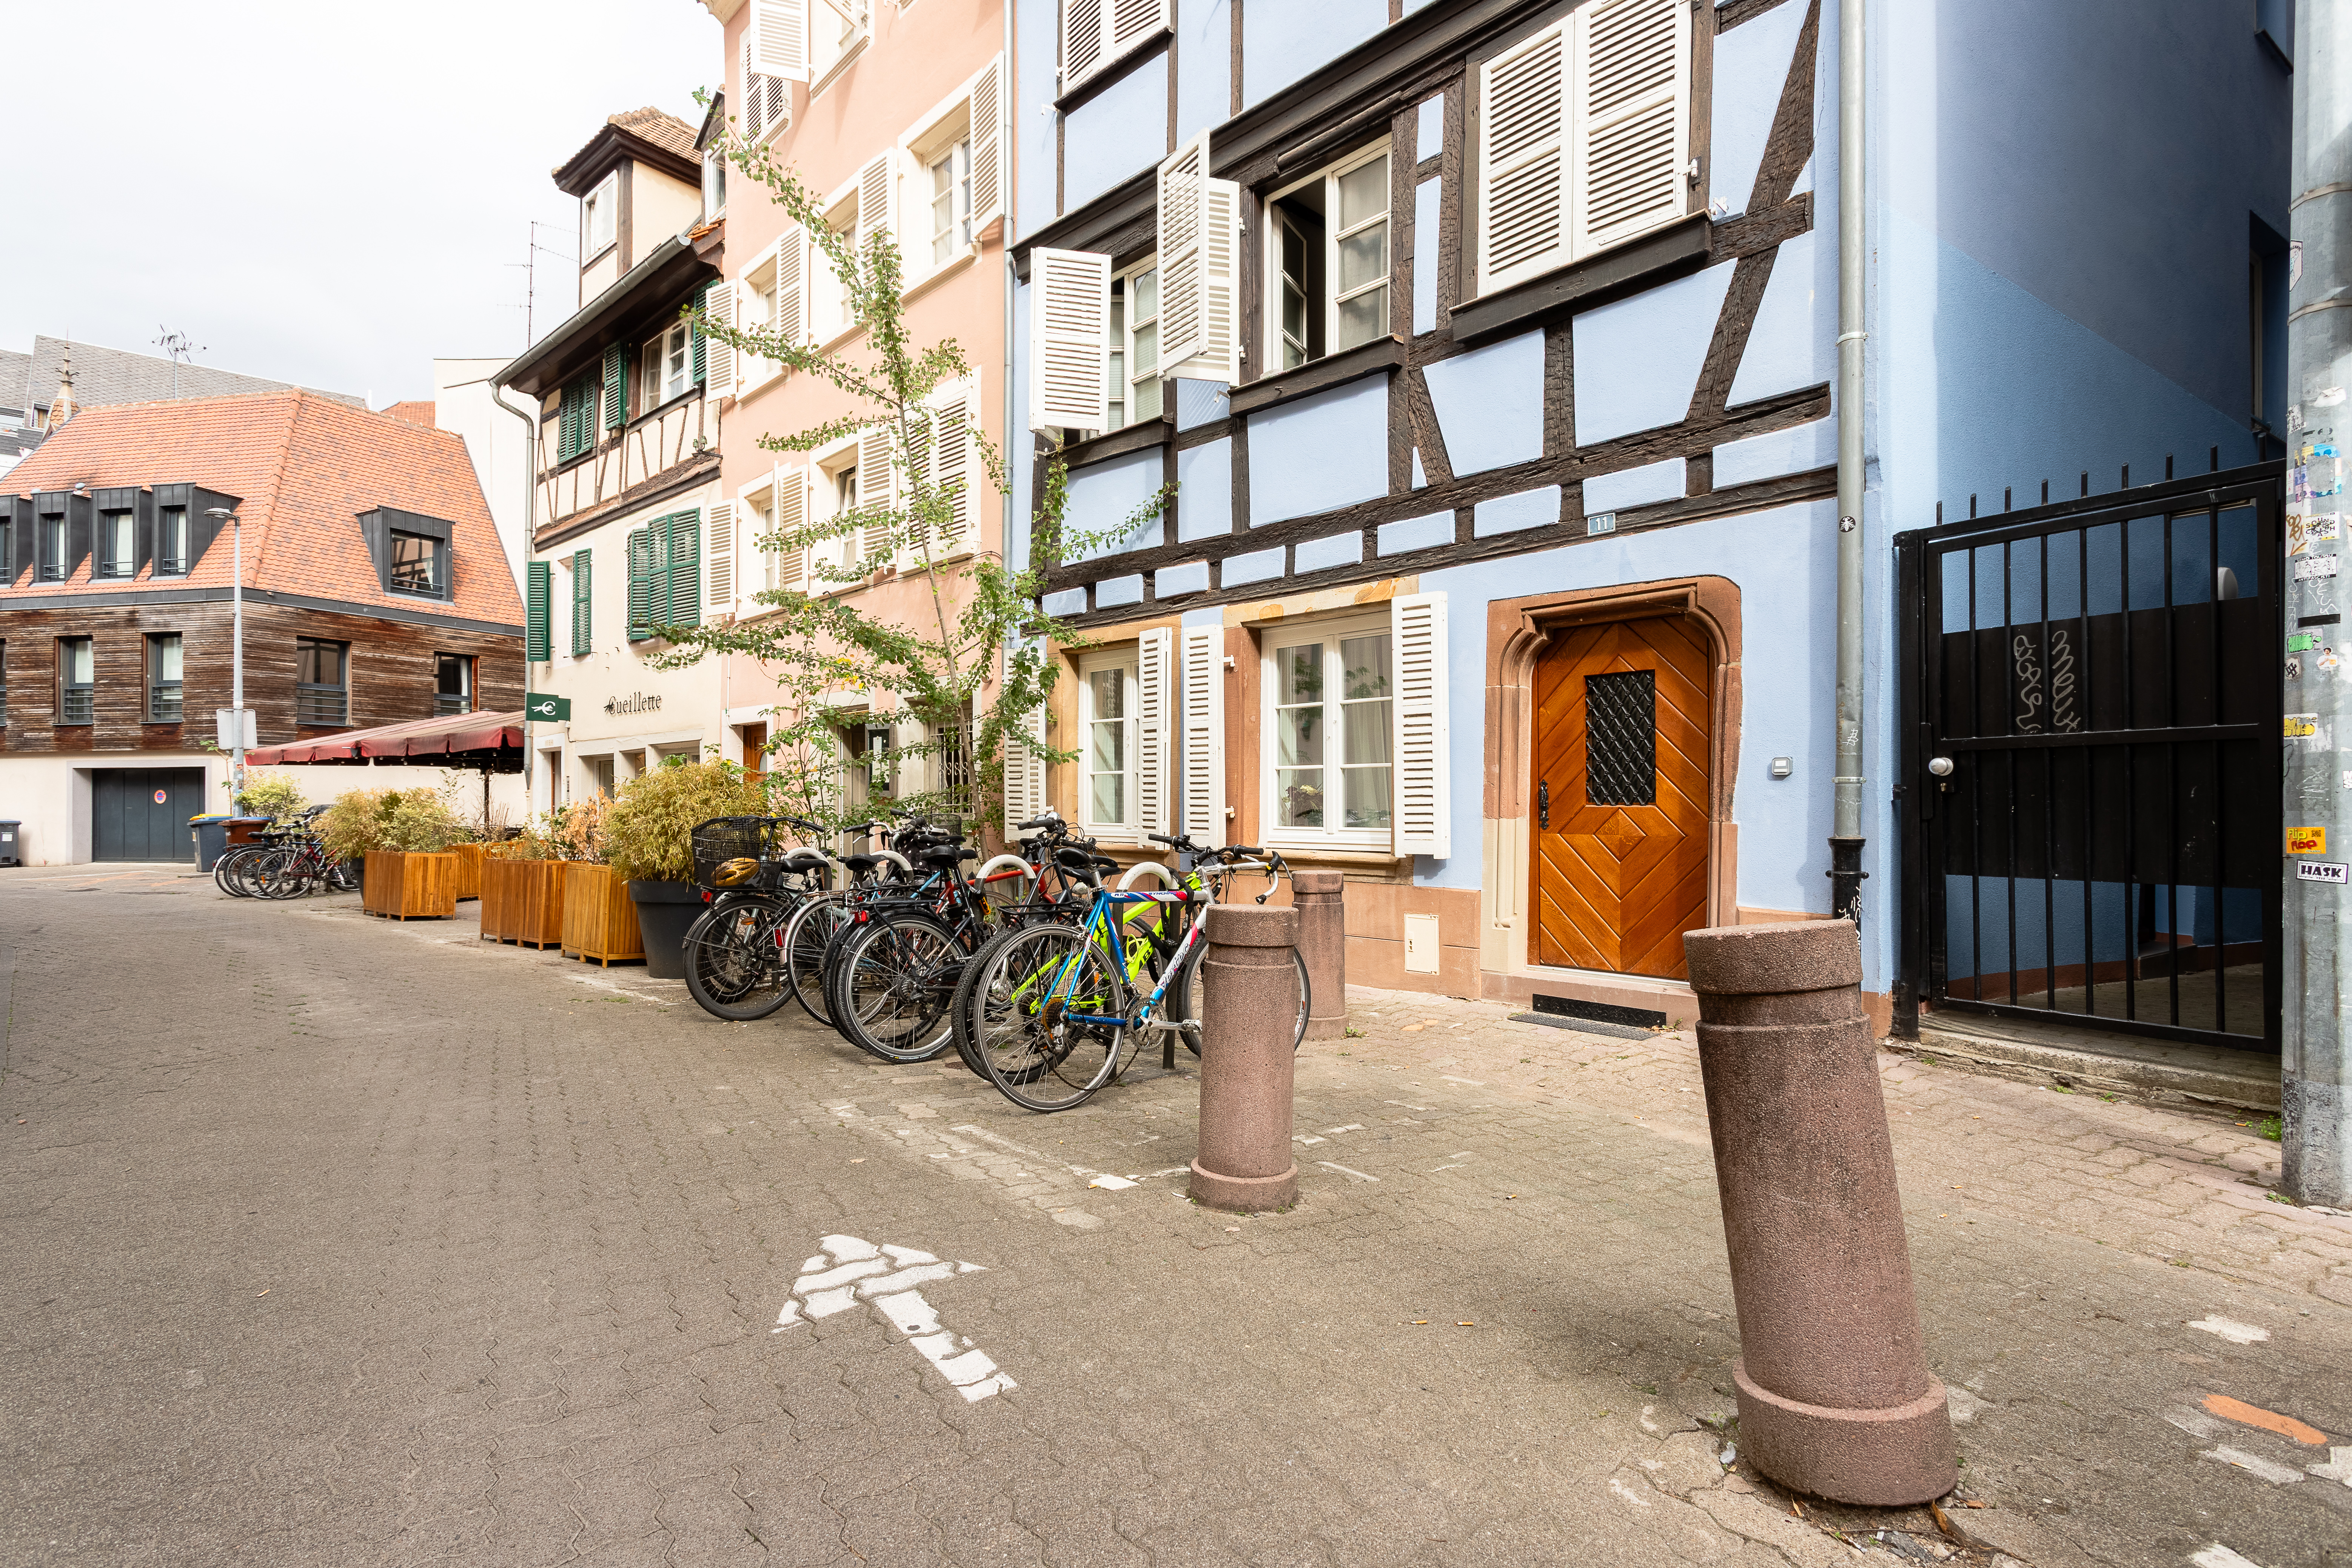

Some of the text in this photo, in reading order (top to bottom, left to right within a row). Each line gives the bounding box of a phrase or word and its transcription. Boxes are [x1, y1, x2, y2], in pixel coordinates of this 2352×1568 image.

[1596, 516, 1607, 531] 11
[2306, 518, 2335, 528] SOUND
[604, 691, 661, 714] Cueillette
[2287, 828, 2307, 841] flip
[2291, 840, 2317, 851] flop
[2301, 865, 2342, 878] HASK
[1157, 943, 1191, 991] Vertec
